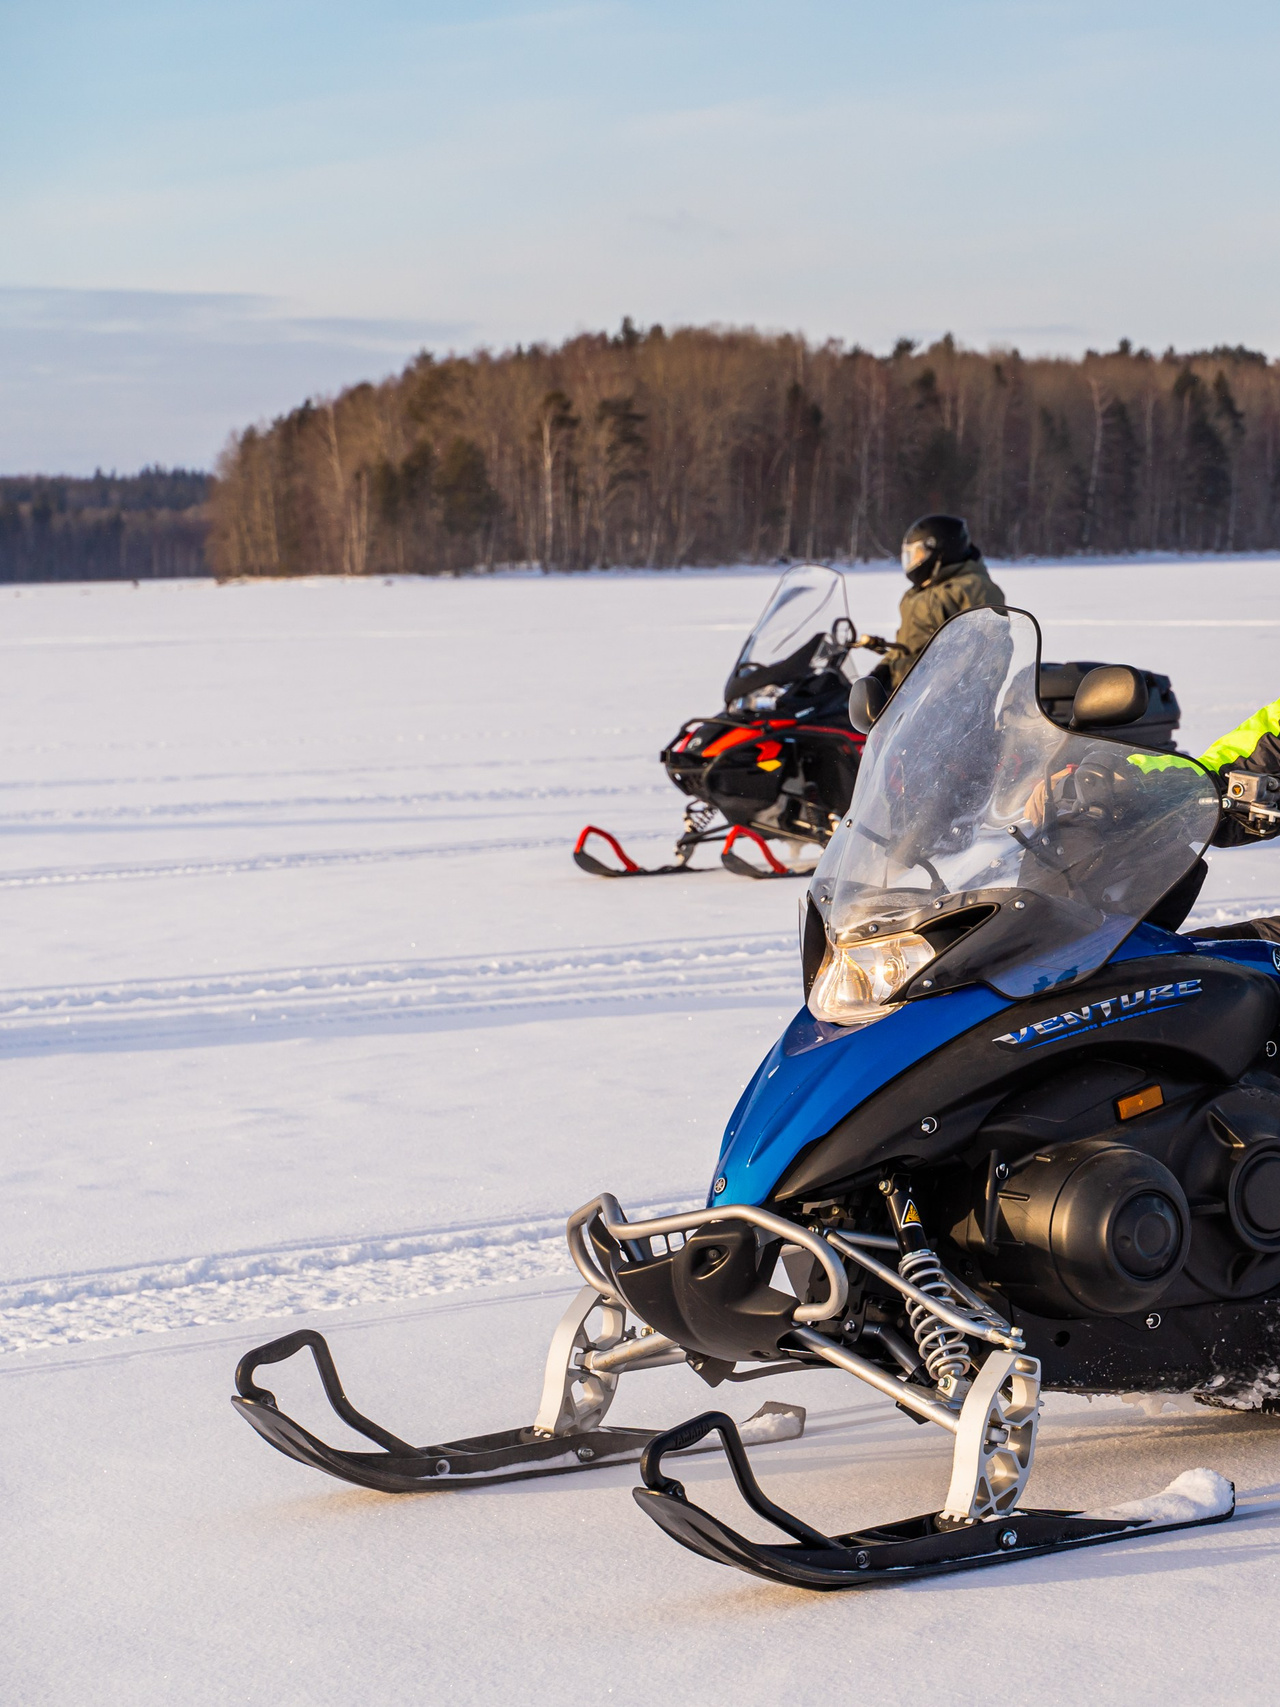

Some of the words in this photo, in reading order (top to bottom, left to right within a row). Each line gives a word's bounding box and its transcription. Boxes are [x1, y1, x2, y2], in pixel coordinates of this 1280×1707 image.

[992, 979, 1203, 1045] VENTURE
[1067, 1023, 1098, 1038] multi
[1101, 1010, 1147, 1028] purpose
